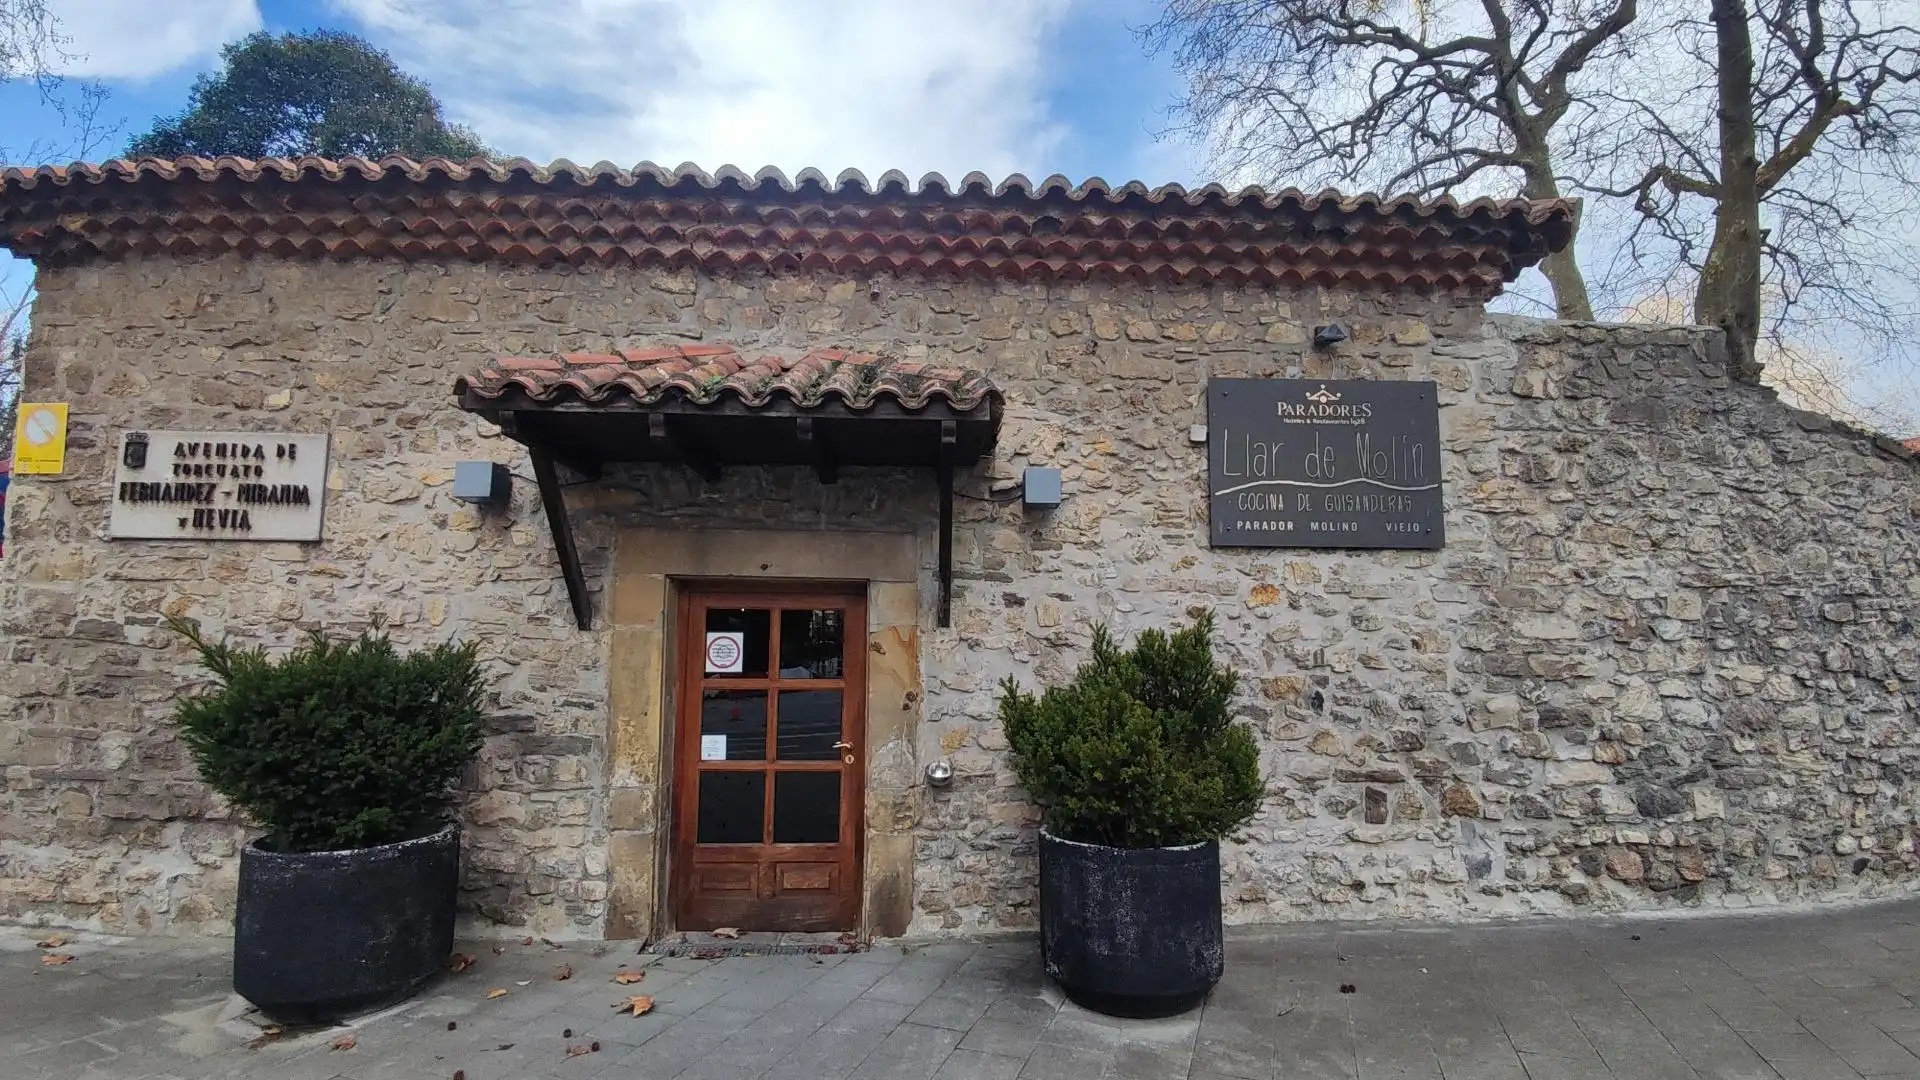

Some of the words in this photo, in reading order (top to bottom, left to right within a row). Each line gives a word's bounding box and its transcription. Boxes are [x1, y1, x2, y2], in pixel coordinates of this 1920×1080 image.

[173, 442, 266, 461] AVENIDA
[276, 443, 298, 461] DE
[1223, 429, 1285, 478] Llar
[1305, 430, 1336, 479] de
[173, 463, 264, 479] TORCUATO
[119, 482, 217, 504] FERNANDEZ
[237, 483, 311, 506] MIRANDA
[1238, 492, 1285, 512] COCINA
[1297, 493, 1314, 512] DE
[1324, 494, 1413, 513] GUISANDERAS
[192, 508, 252, 531] HEVIA
[1236, 520, 1295, 532] PARADOR
[1310, 521, 1359, 533] MOLINO
[1385, 522, 1421, 533] VIEJO
